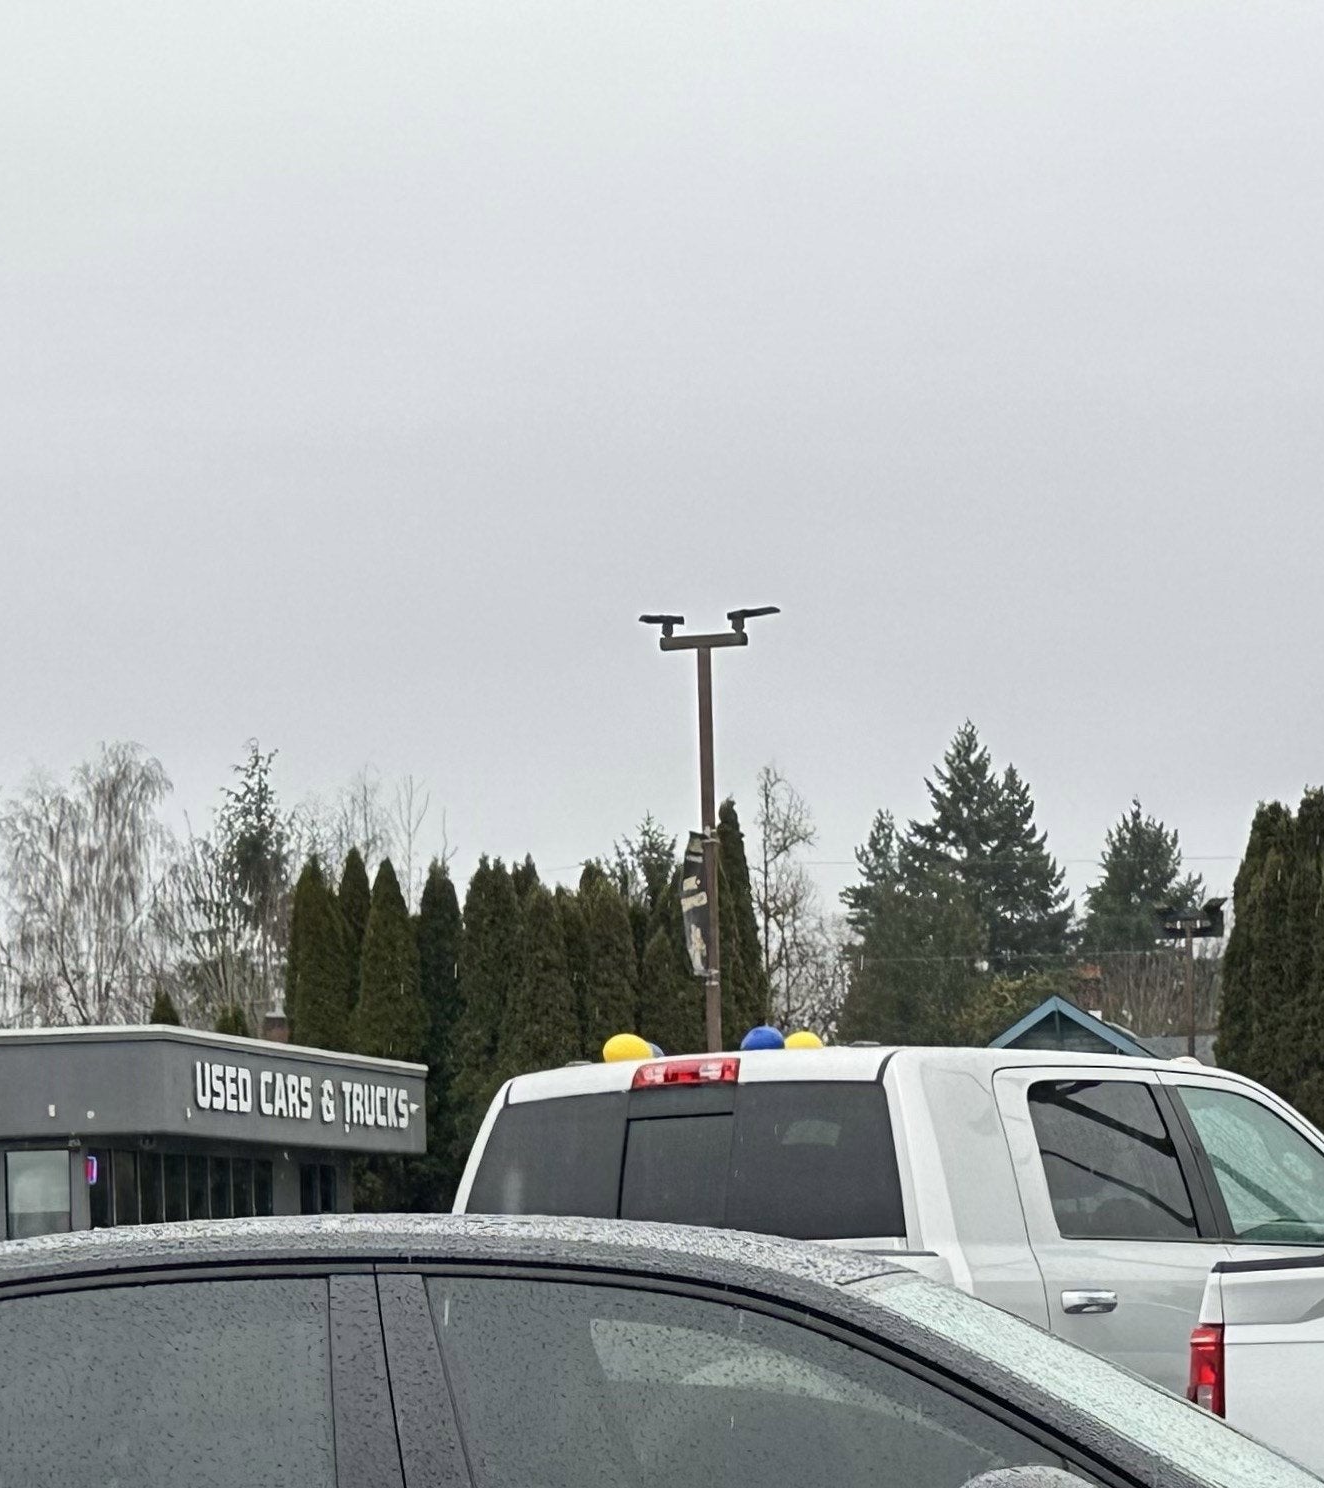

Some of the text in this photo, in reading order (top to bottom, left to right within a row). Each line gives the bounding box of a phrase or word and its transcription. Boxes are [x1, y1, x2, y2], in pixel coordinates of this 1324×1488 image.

[196, 1060, 410, 1131] USED CARS & TRUCKS
